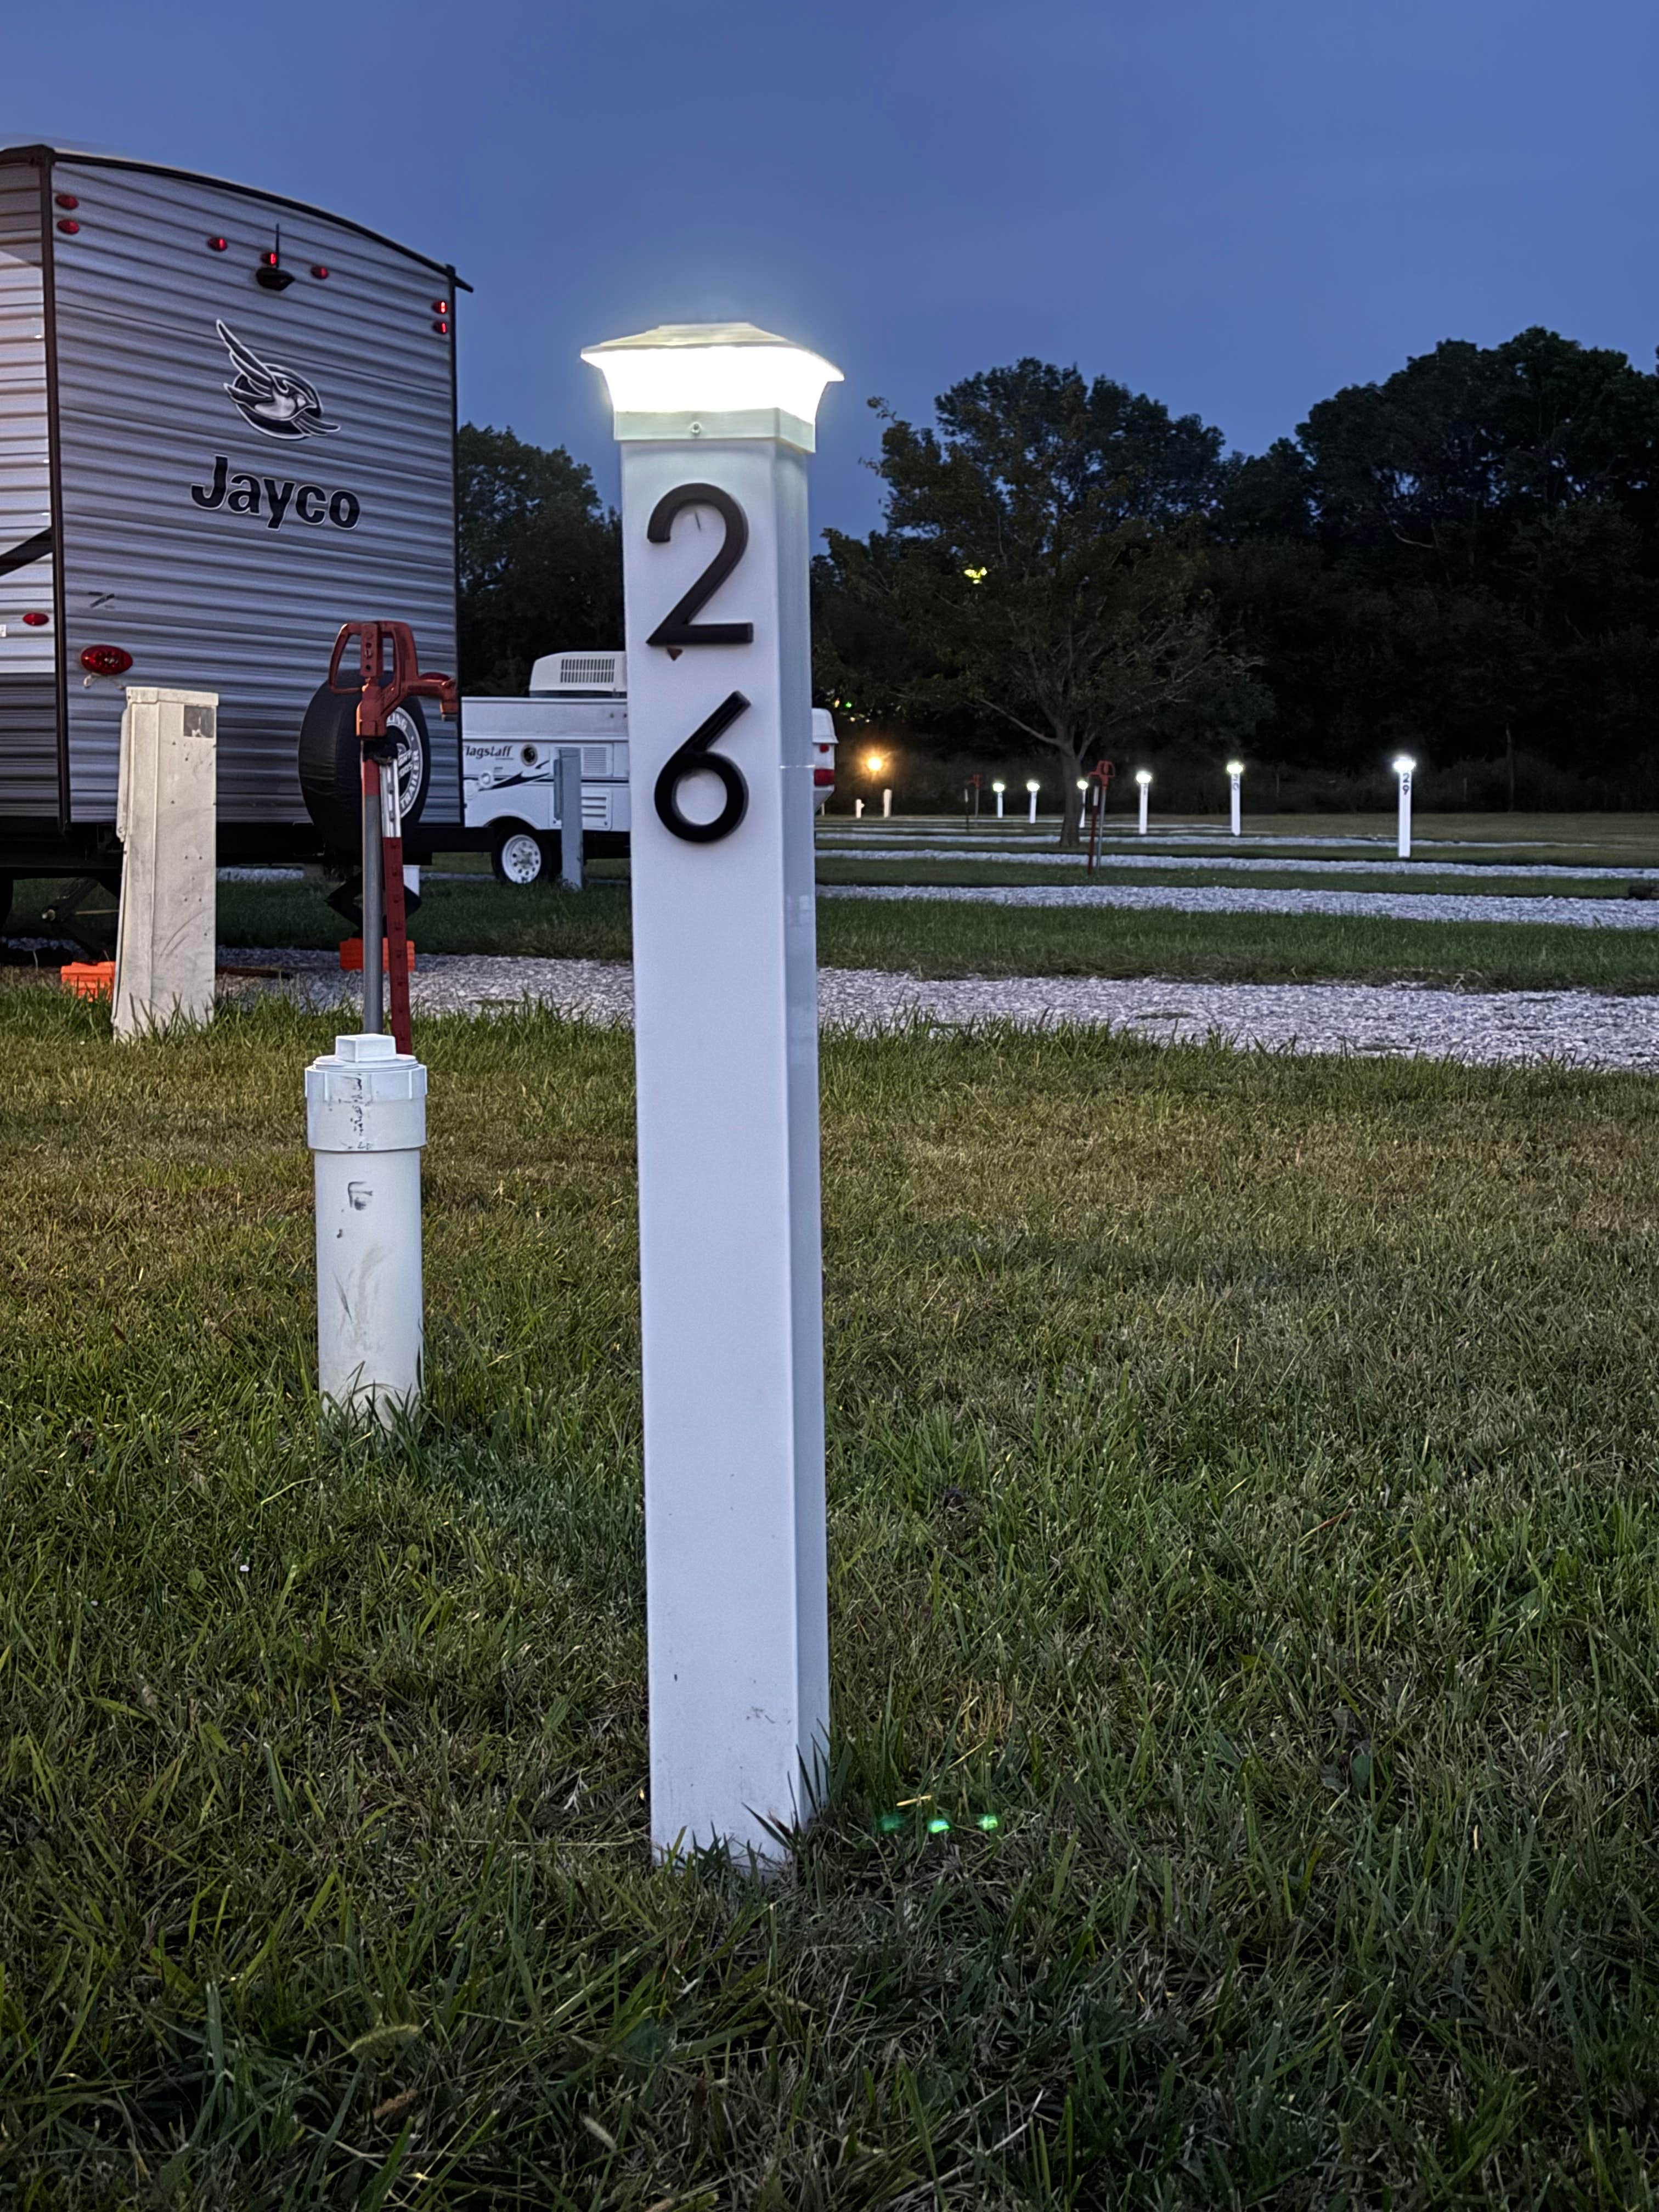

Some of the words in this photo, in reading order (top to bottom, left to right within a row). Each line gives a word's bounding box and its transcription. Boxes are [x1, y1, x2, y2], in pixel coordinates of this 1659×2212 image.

[191, 454, 360, 531] Jayco
[646, 482, 754, 843] 26
[464, 746, 514, 759] lagstaff
[1402, 772, 1410, 796] 29
